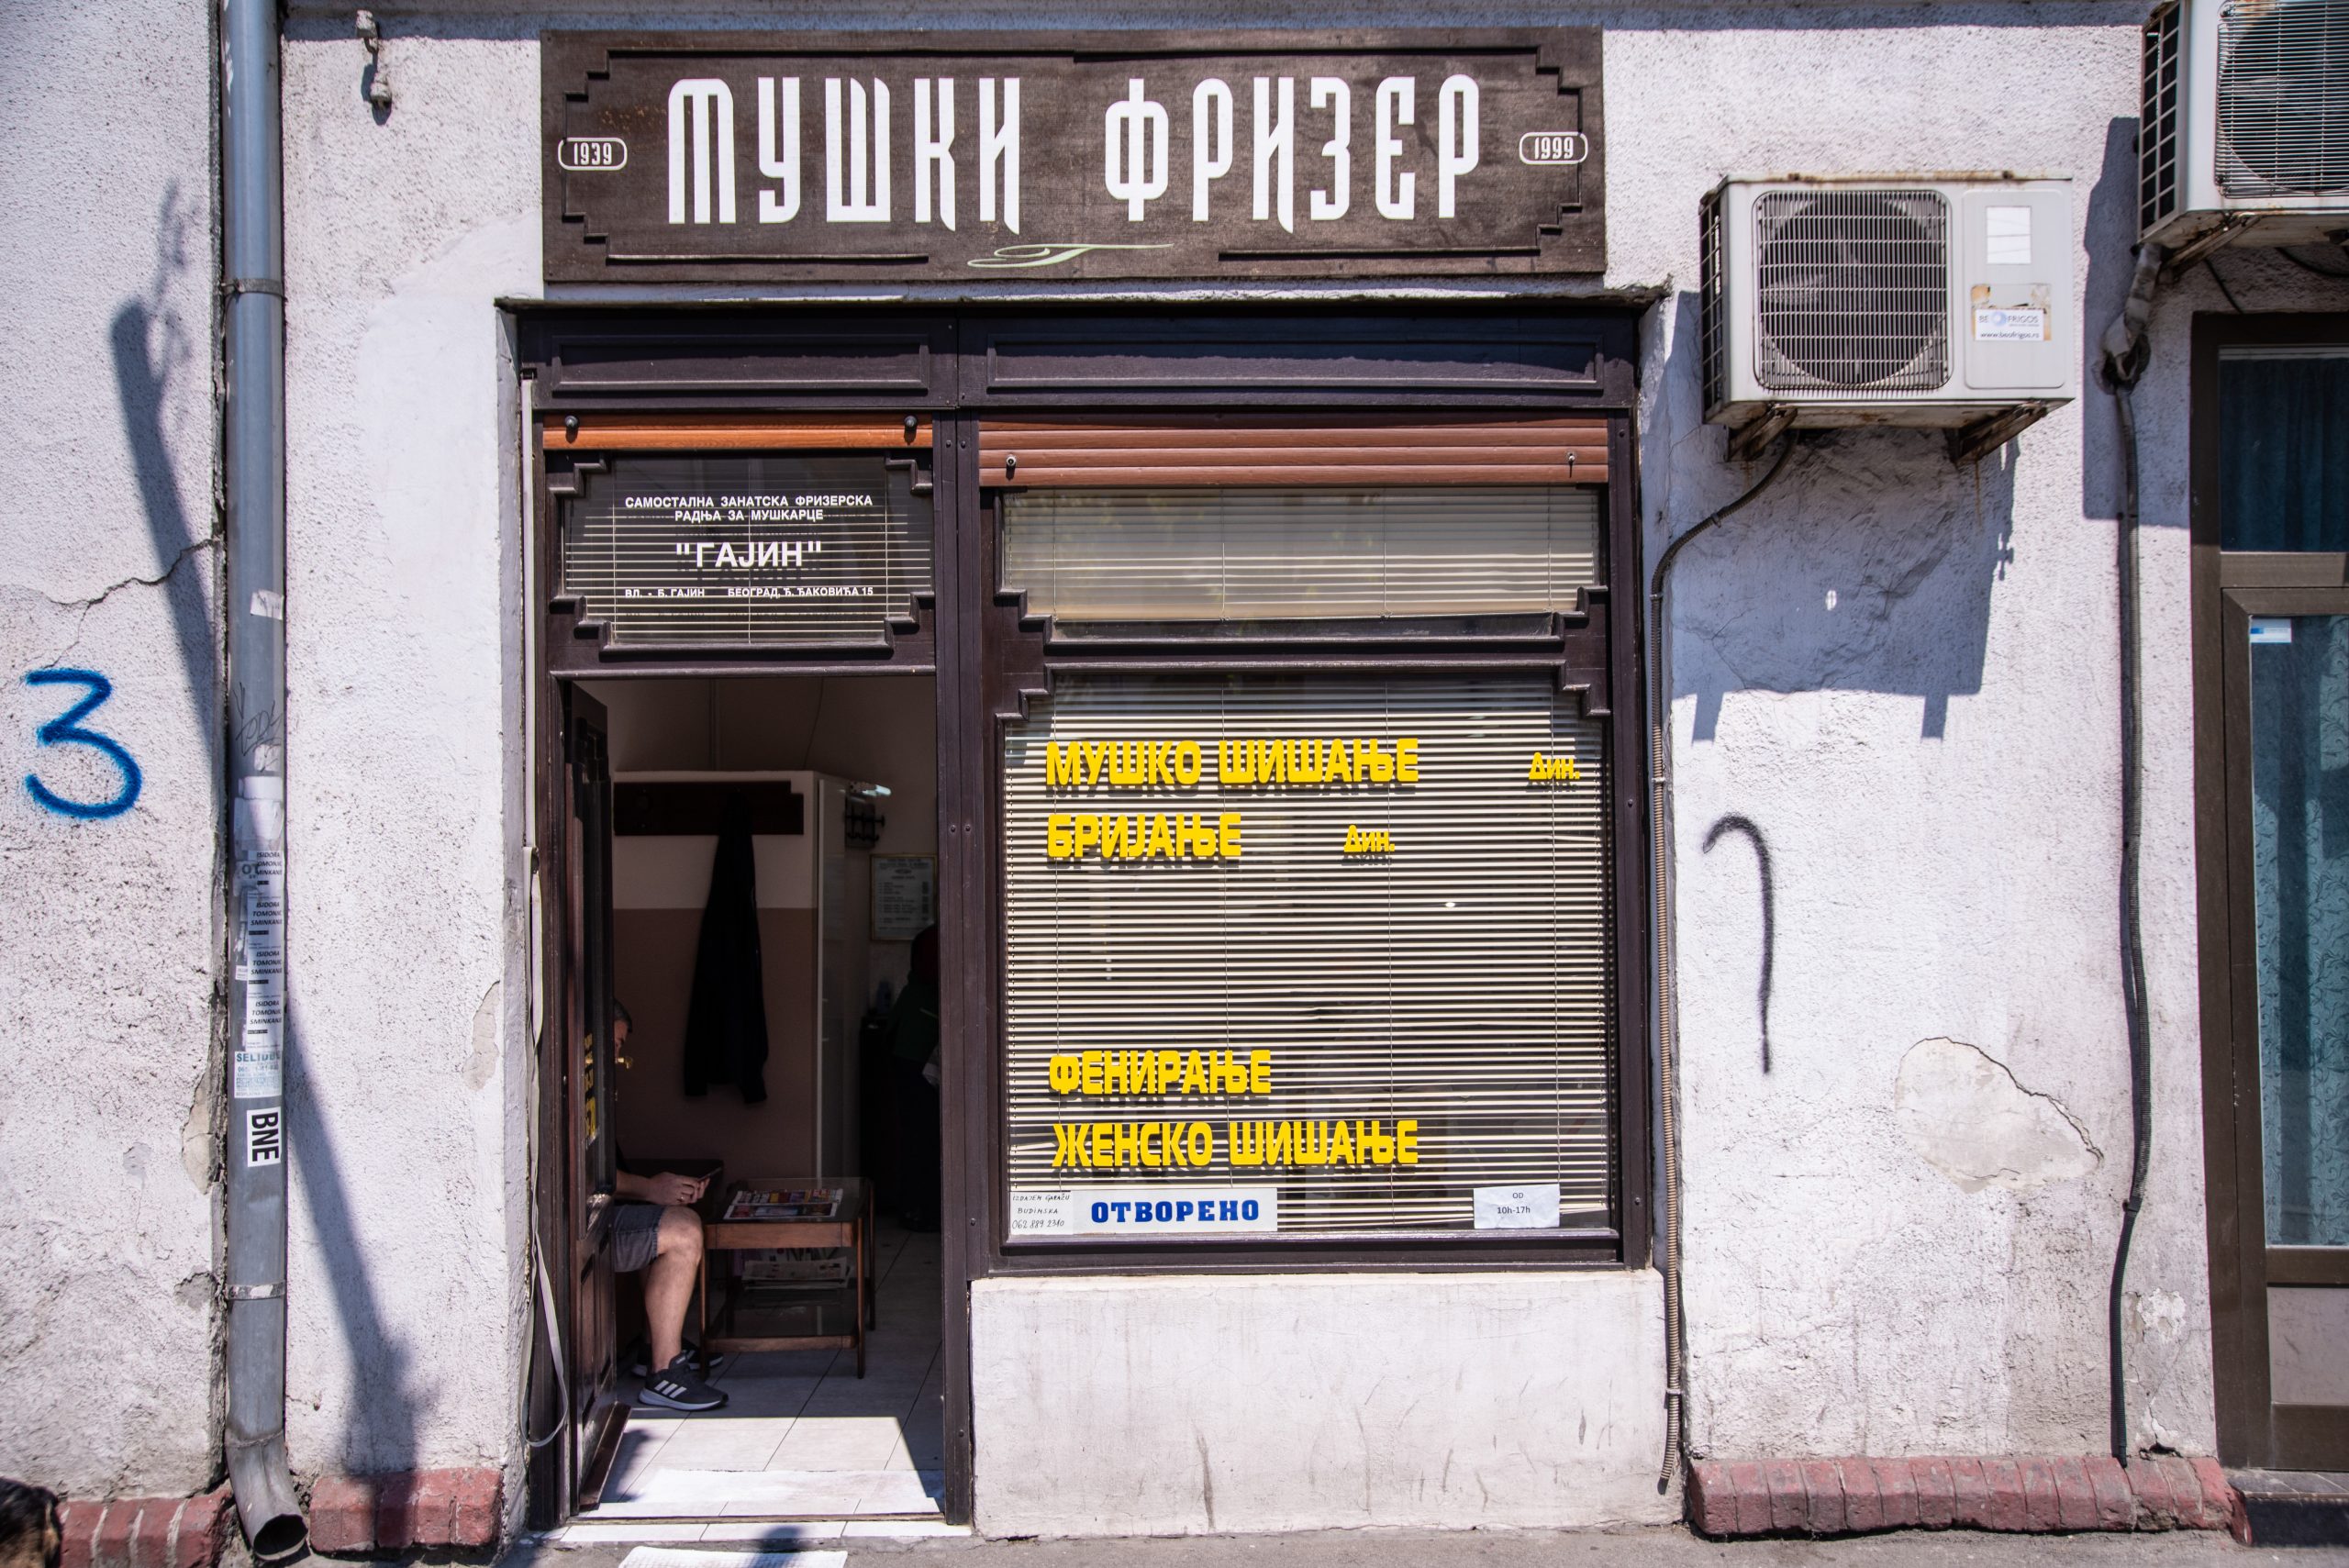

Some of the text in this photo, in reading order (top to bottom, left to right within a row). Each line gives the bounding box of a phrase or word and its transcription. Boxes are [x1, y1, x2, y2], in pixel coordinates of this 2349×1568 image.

[573, 142, 613, 166] 1939
[668, 74, 1479, 235] МУШКИ ФРИЗЕР
[1533, 136, 1575, 160] 1999
[625, 495, 873, 508] САМОСТАЛНА ЗАНАТСКА ФРИЗЕРСКА
[674, 509, 824, 524] РАДЊА ЗА МУШКАРЦЕ
[676, 540, 821, 567] "ГАЈИН"
[625, 588, 642, 597] ВЛ.
[657, 588, 668, 597] Б.
[671, 588, 705, 597] ГАЈИН
[862, 586, 874, 595] 15
[26, 668, 142, 819] 3
[1046, 738, 1581, 785] МУШКО ШИШАЊЕ Дин.
[1047, 813, 1396, 859] БРИЈАЊЕ Дин.
[1049, 1049, 1272, 1095] ФЕНИРАЊЕ
[251, 1112, 279, 1162] BNE
[1051, 1119, 1419, 1168] ЖЕНСКО ШИШАЊЕ
[1091, 1198, 1260, 1223] ОТВОРЕНО
[1497, 1206, 1531, 1214] 10h-17h
[1012, 1219, 1028, 1229] 062
